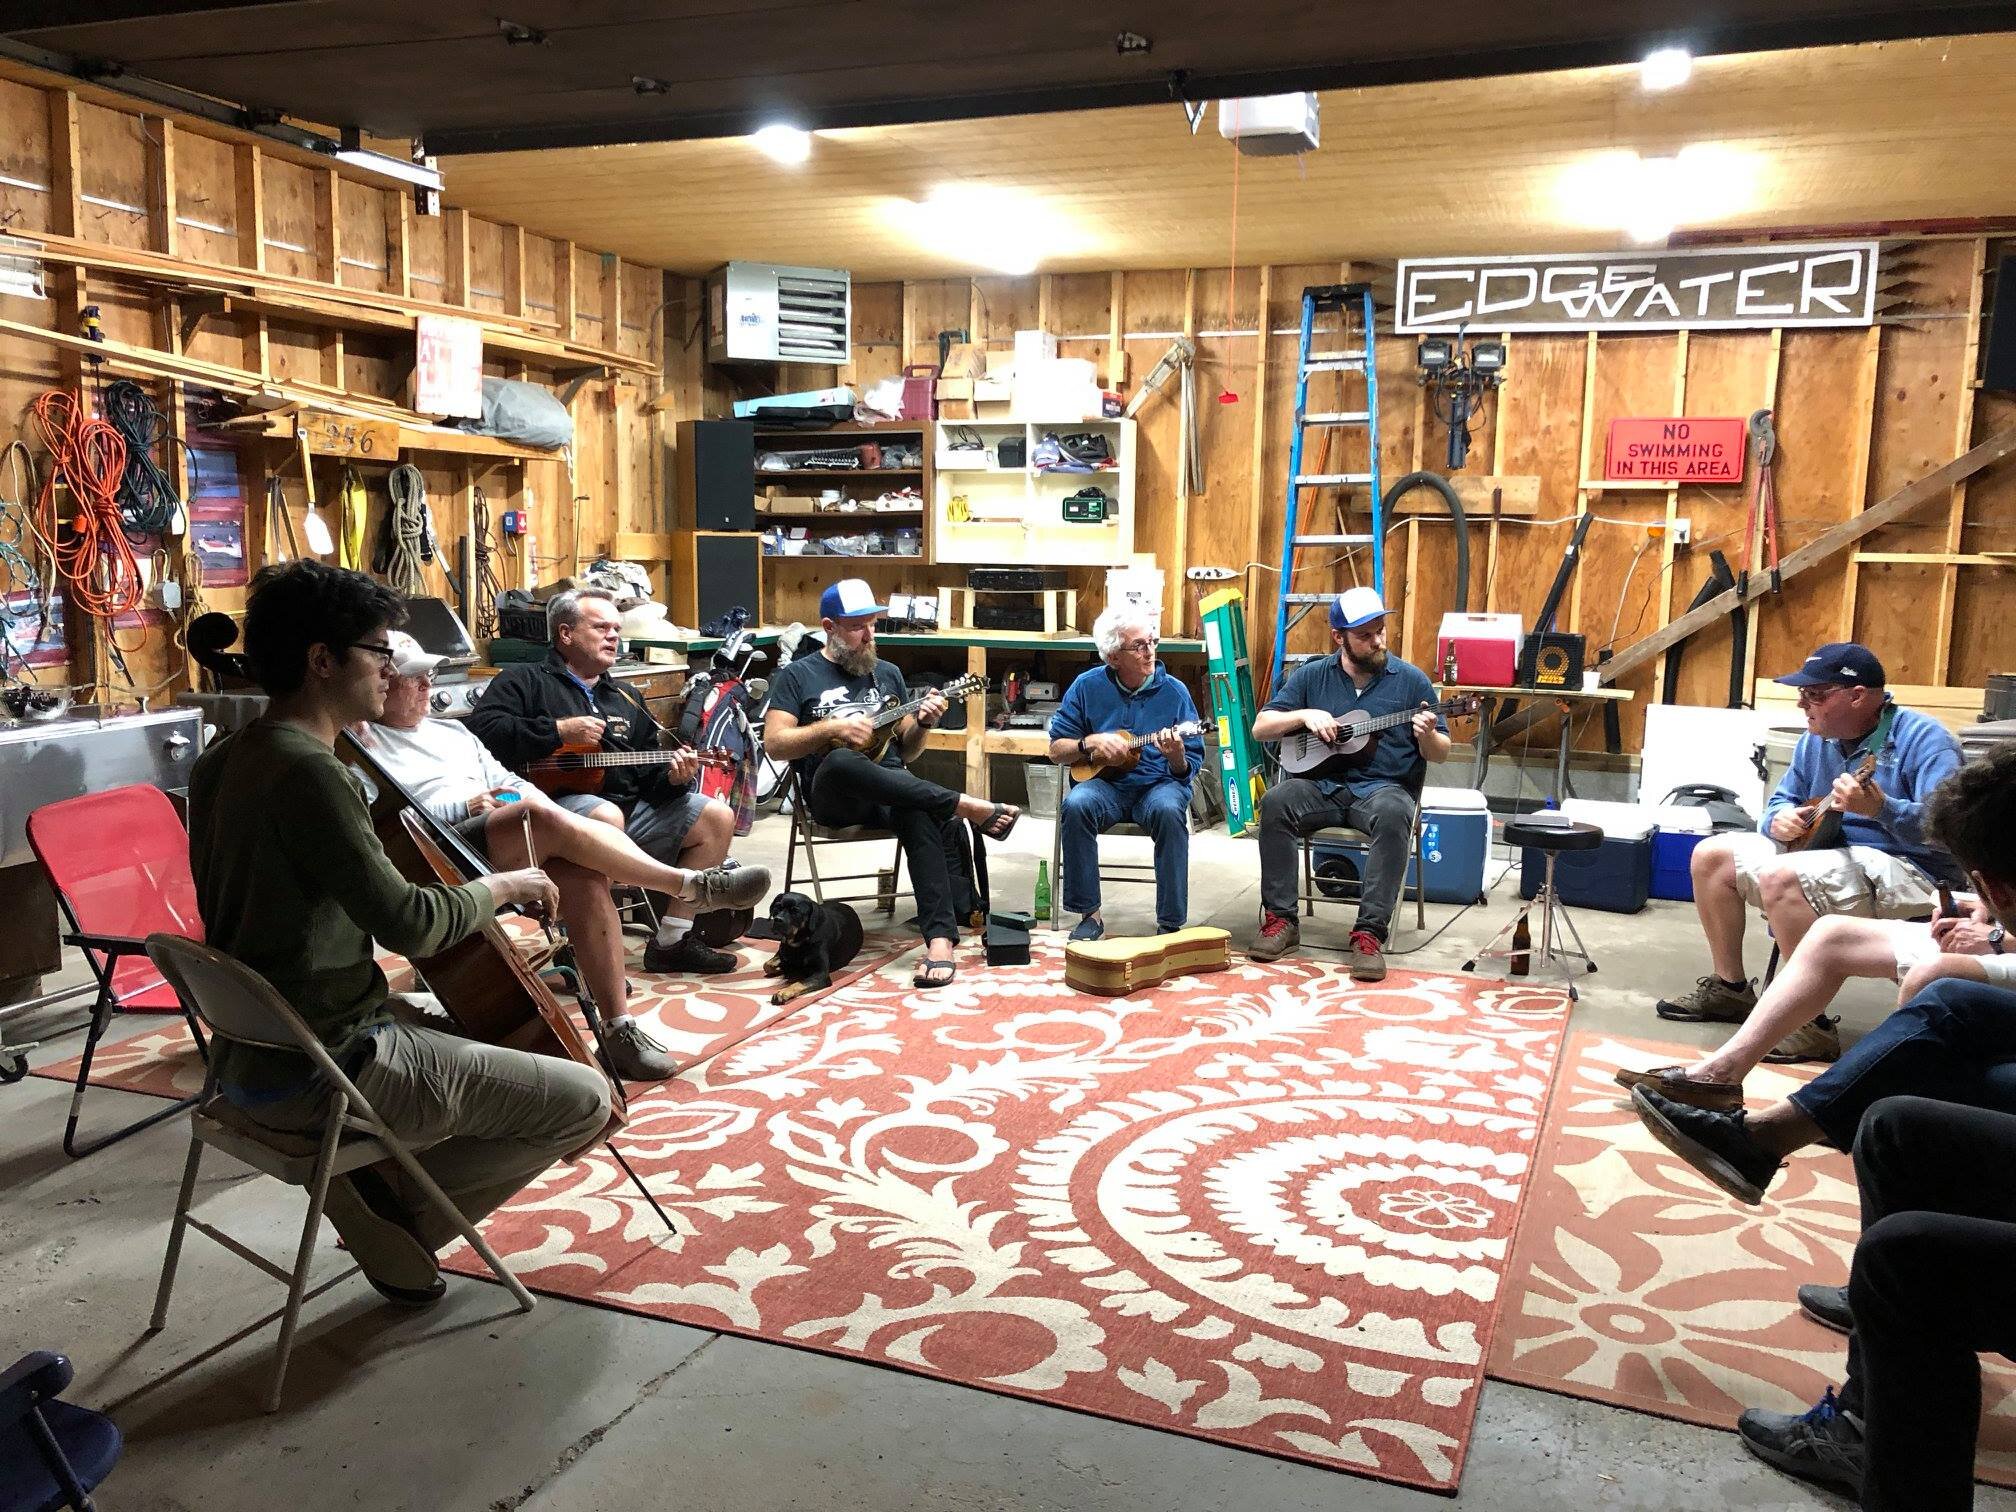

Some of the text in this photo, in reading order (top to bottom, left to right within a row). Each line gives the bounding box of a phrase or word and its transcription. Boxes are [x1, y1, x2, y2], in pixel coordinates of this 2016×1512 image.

[1663, 424, 1690, 439] NO
[1628, 443, 1723, 457] SWIMMING
[1617, 461, 1730, 475] IN THIS AREA
